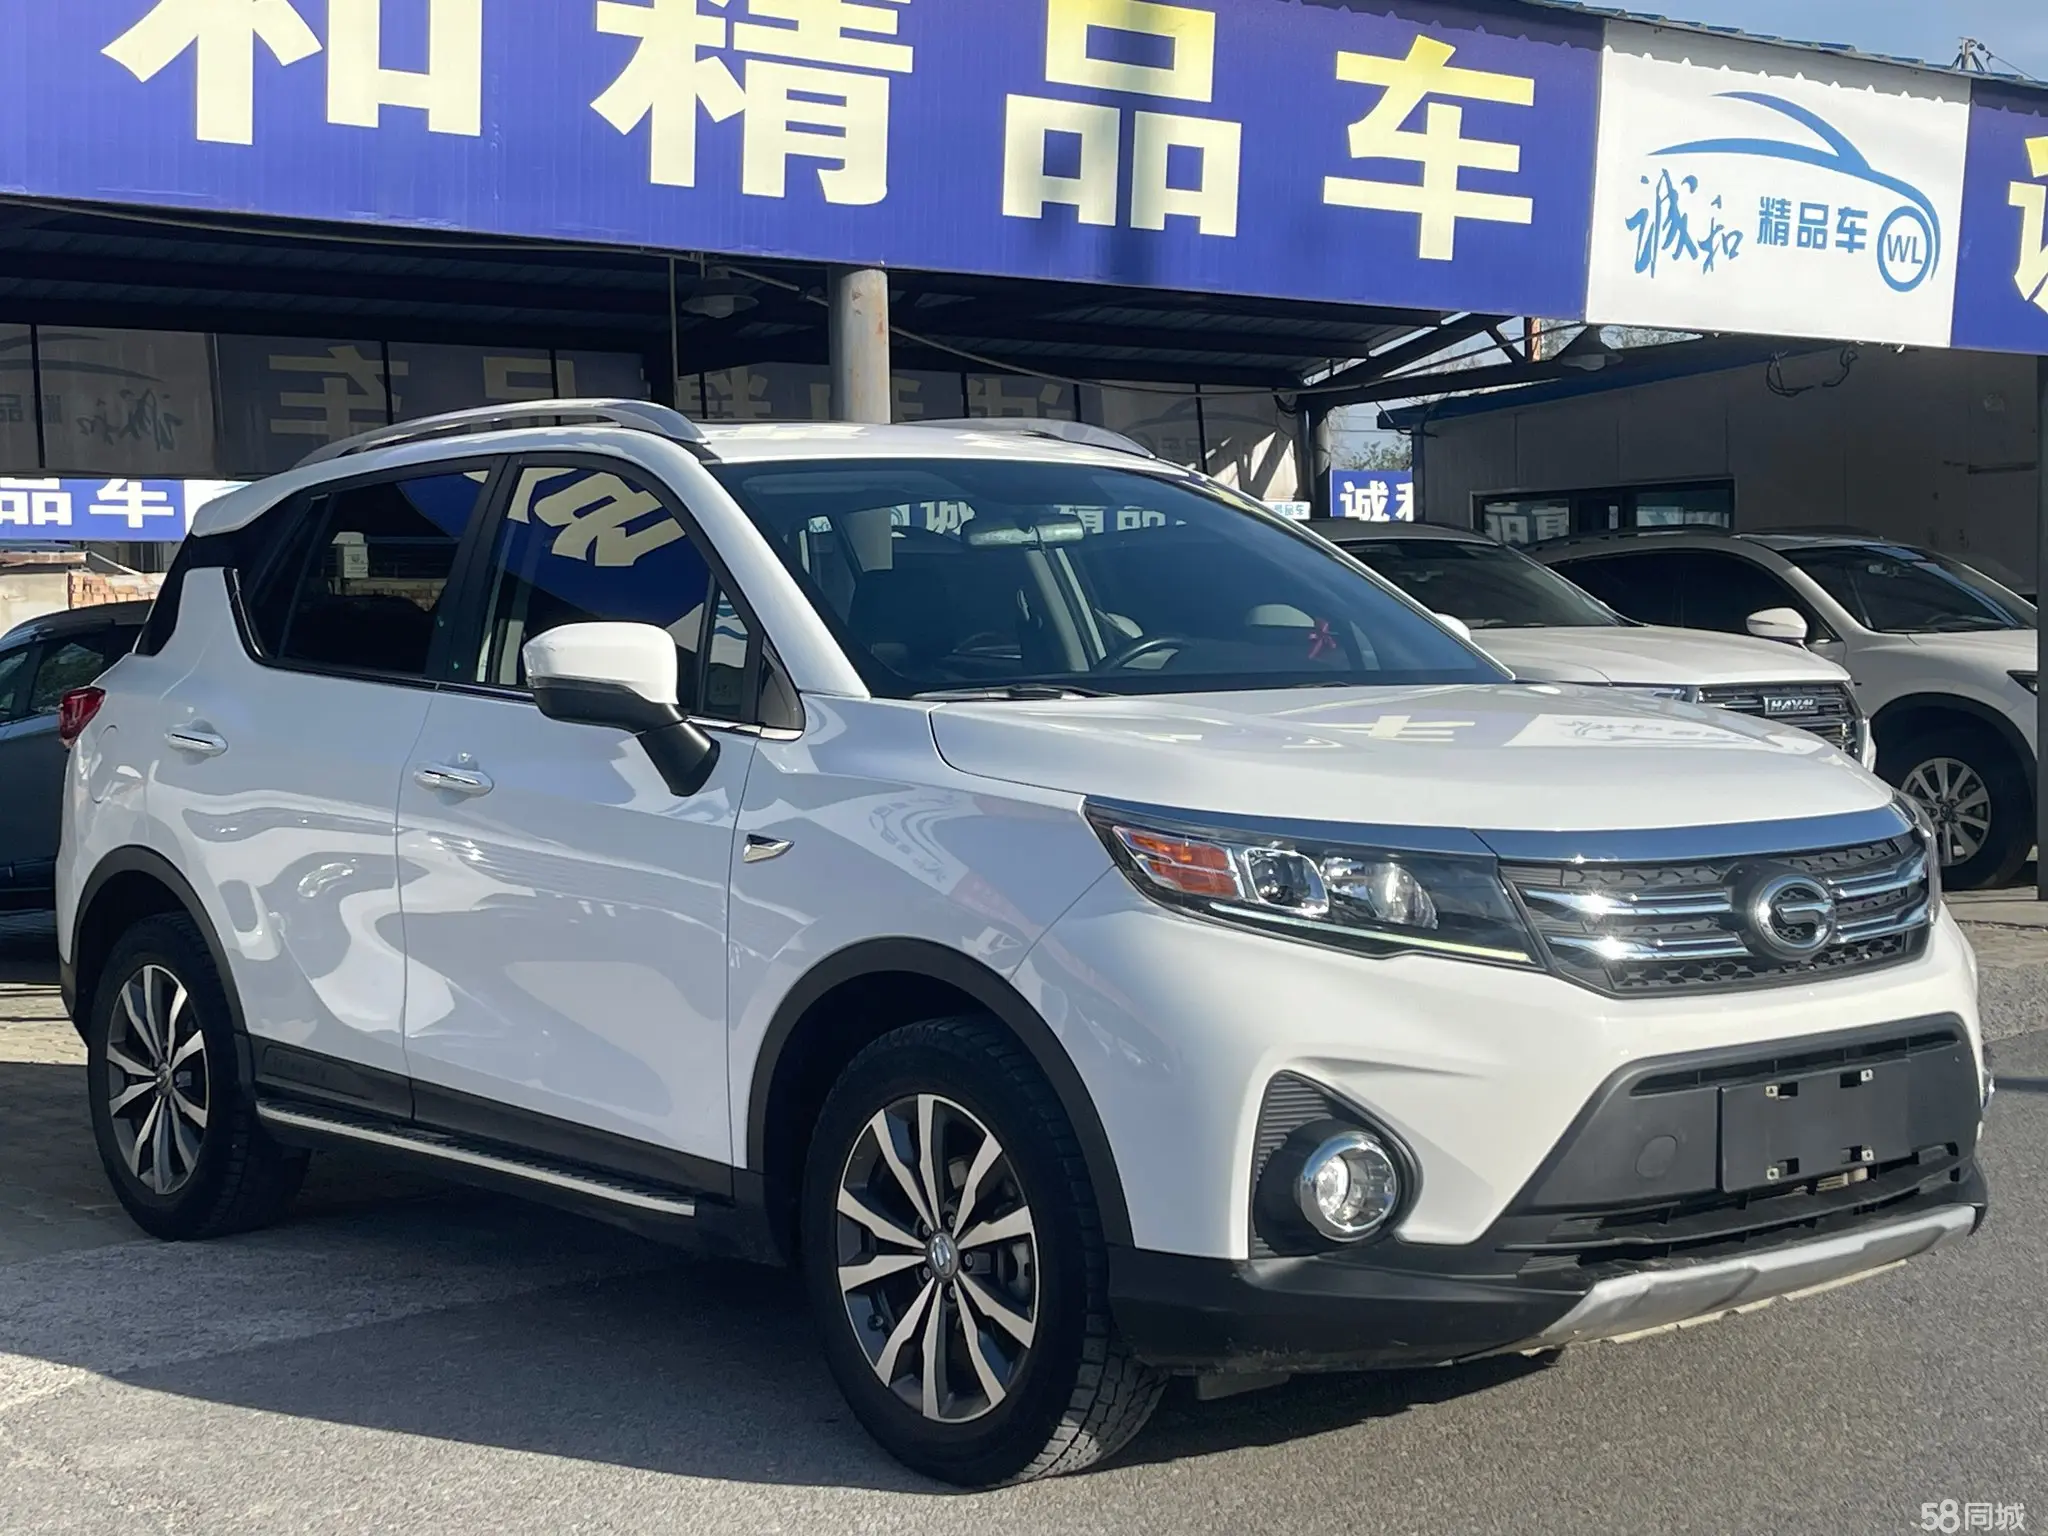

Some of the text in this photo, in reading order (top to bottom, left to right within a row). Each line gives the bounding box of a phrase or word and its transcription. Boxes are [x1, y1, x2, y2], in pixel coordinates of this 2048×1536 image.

[1756, 196, 1868, 253] 精品车
[1887, 234, 1923, 264] WL
